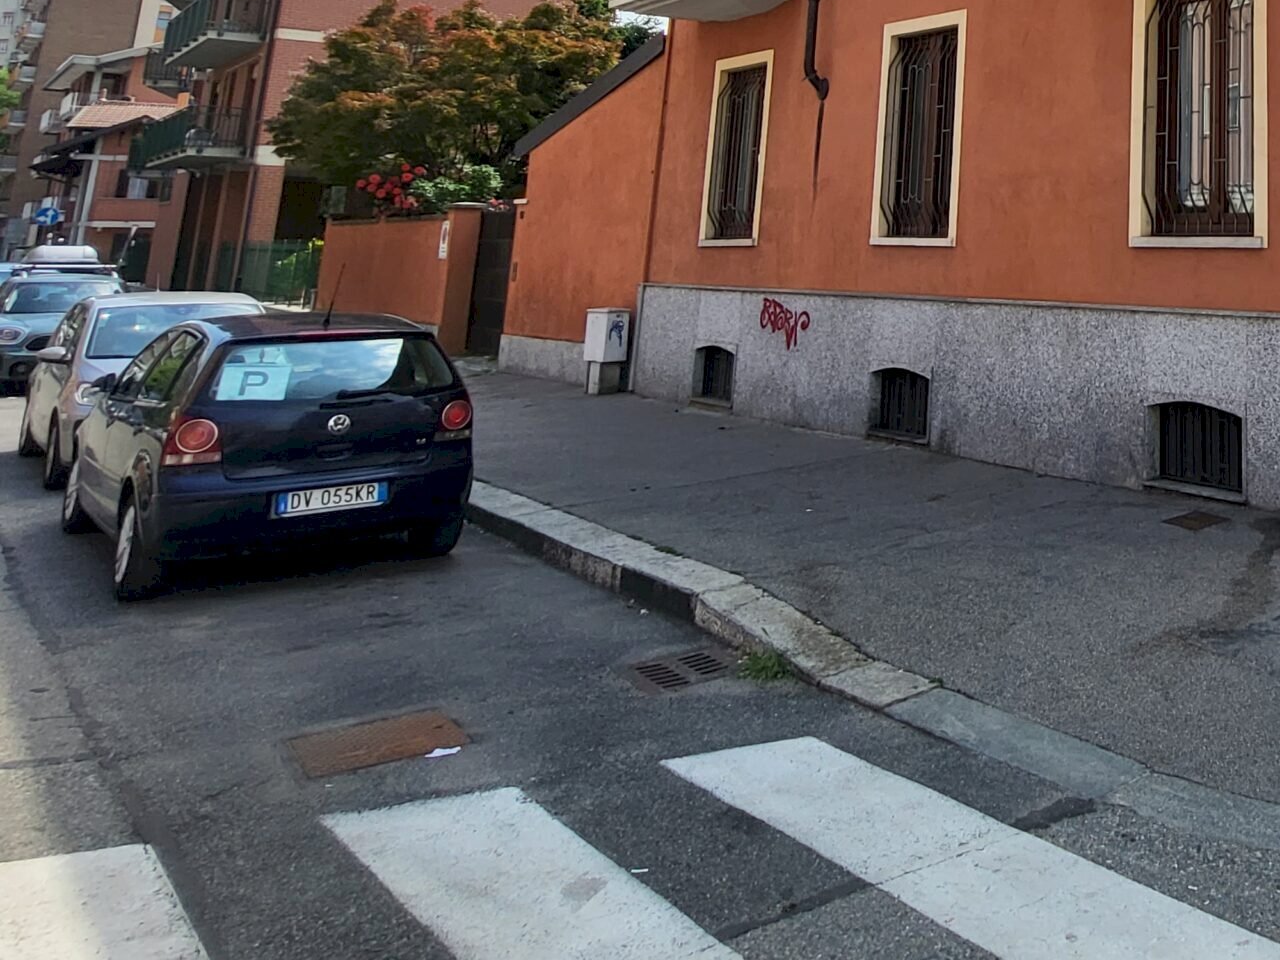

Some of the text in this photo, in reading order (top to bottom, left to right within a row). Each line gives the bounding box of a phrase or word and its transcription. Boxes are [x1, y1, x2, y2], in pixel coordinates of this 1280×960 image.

[238, 371, 269, 396] P
[291, 484, 376, 510] DV 055KR
